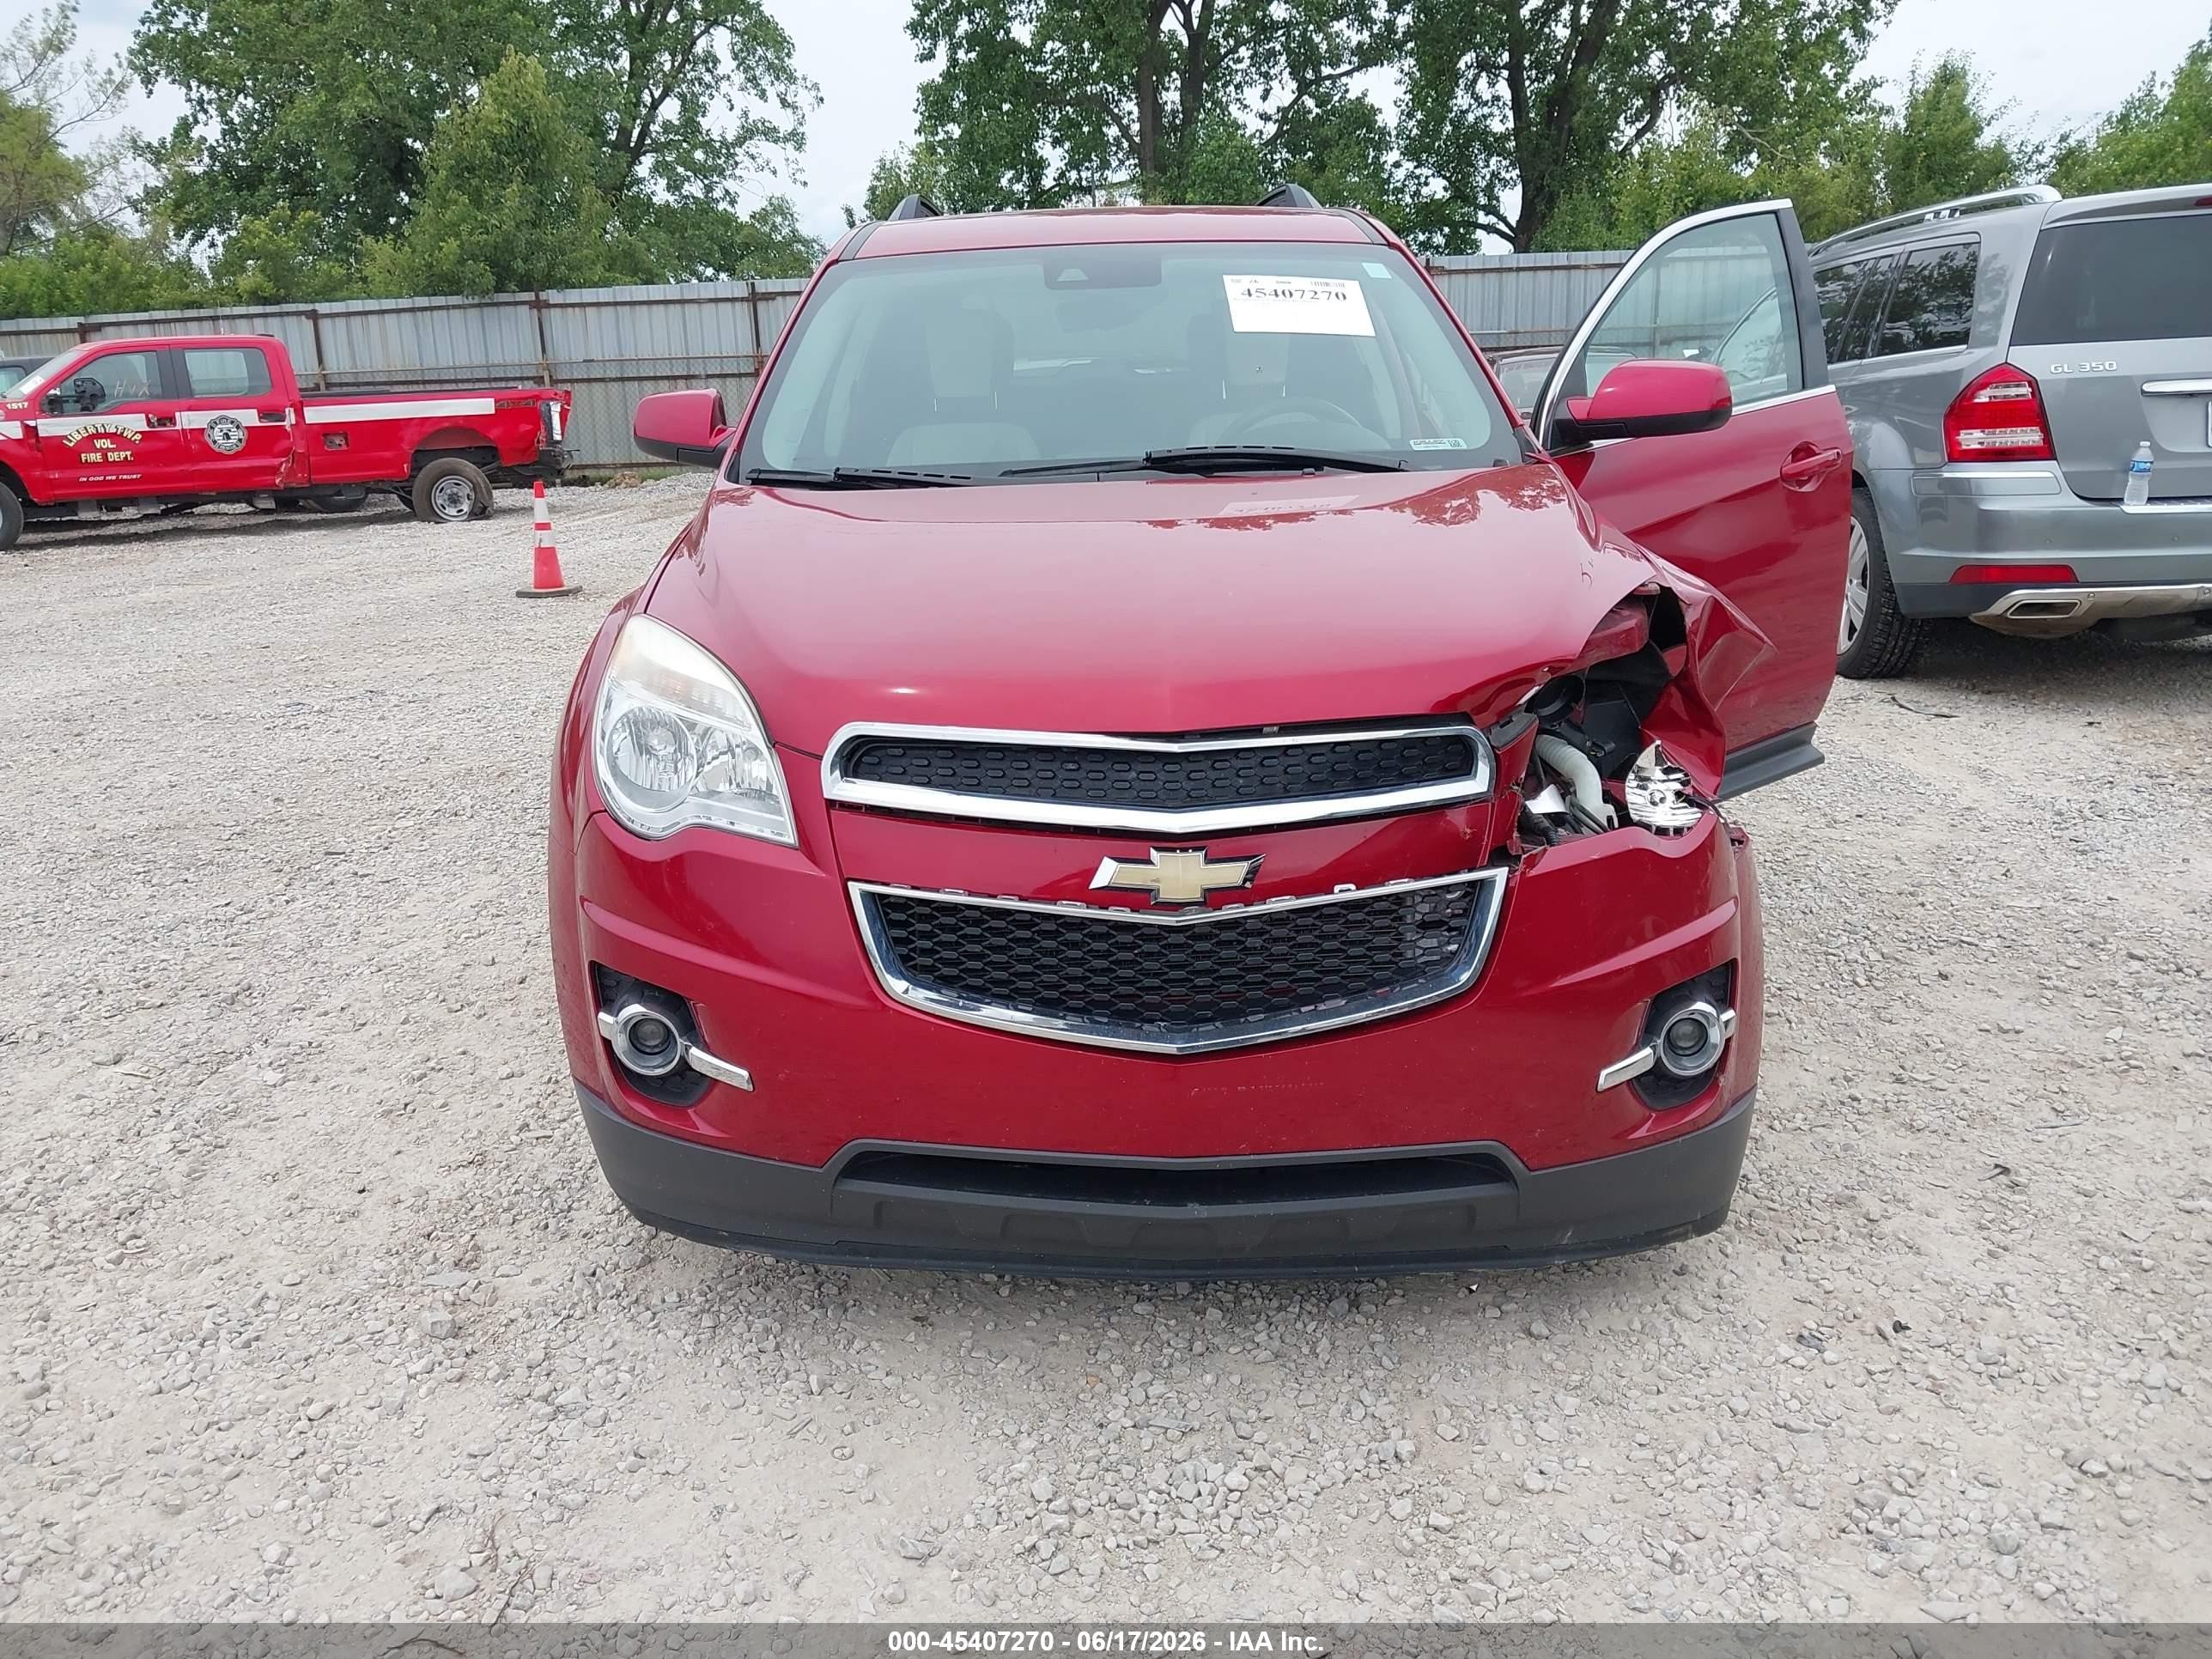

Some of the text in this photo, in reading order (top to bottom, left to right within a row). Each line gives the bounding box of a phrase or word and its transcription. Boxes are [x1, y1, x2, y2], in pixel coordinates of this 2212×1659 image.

[1241, 288, 1347, 301] 45407270
[2051, 361, 2118, 374] GL 350
[6, 401, 29, 410] 1517
[62, 422, 112, 447] LIBERTY
[94, 438, 117, 449] VOL.
[81, 450, 134, 464] FIRE DEPT.
